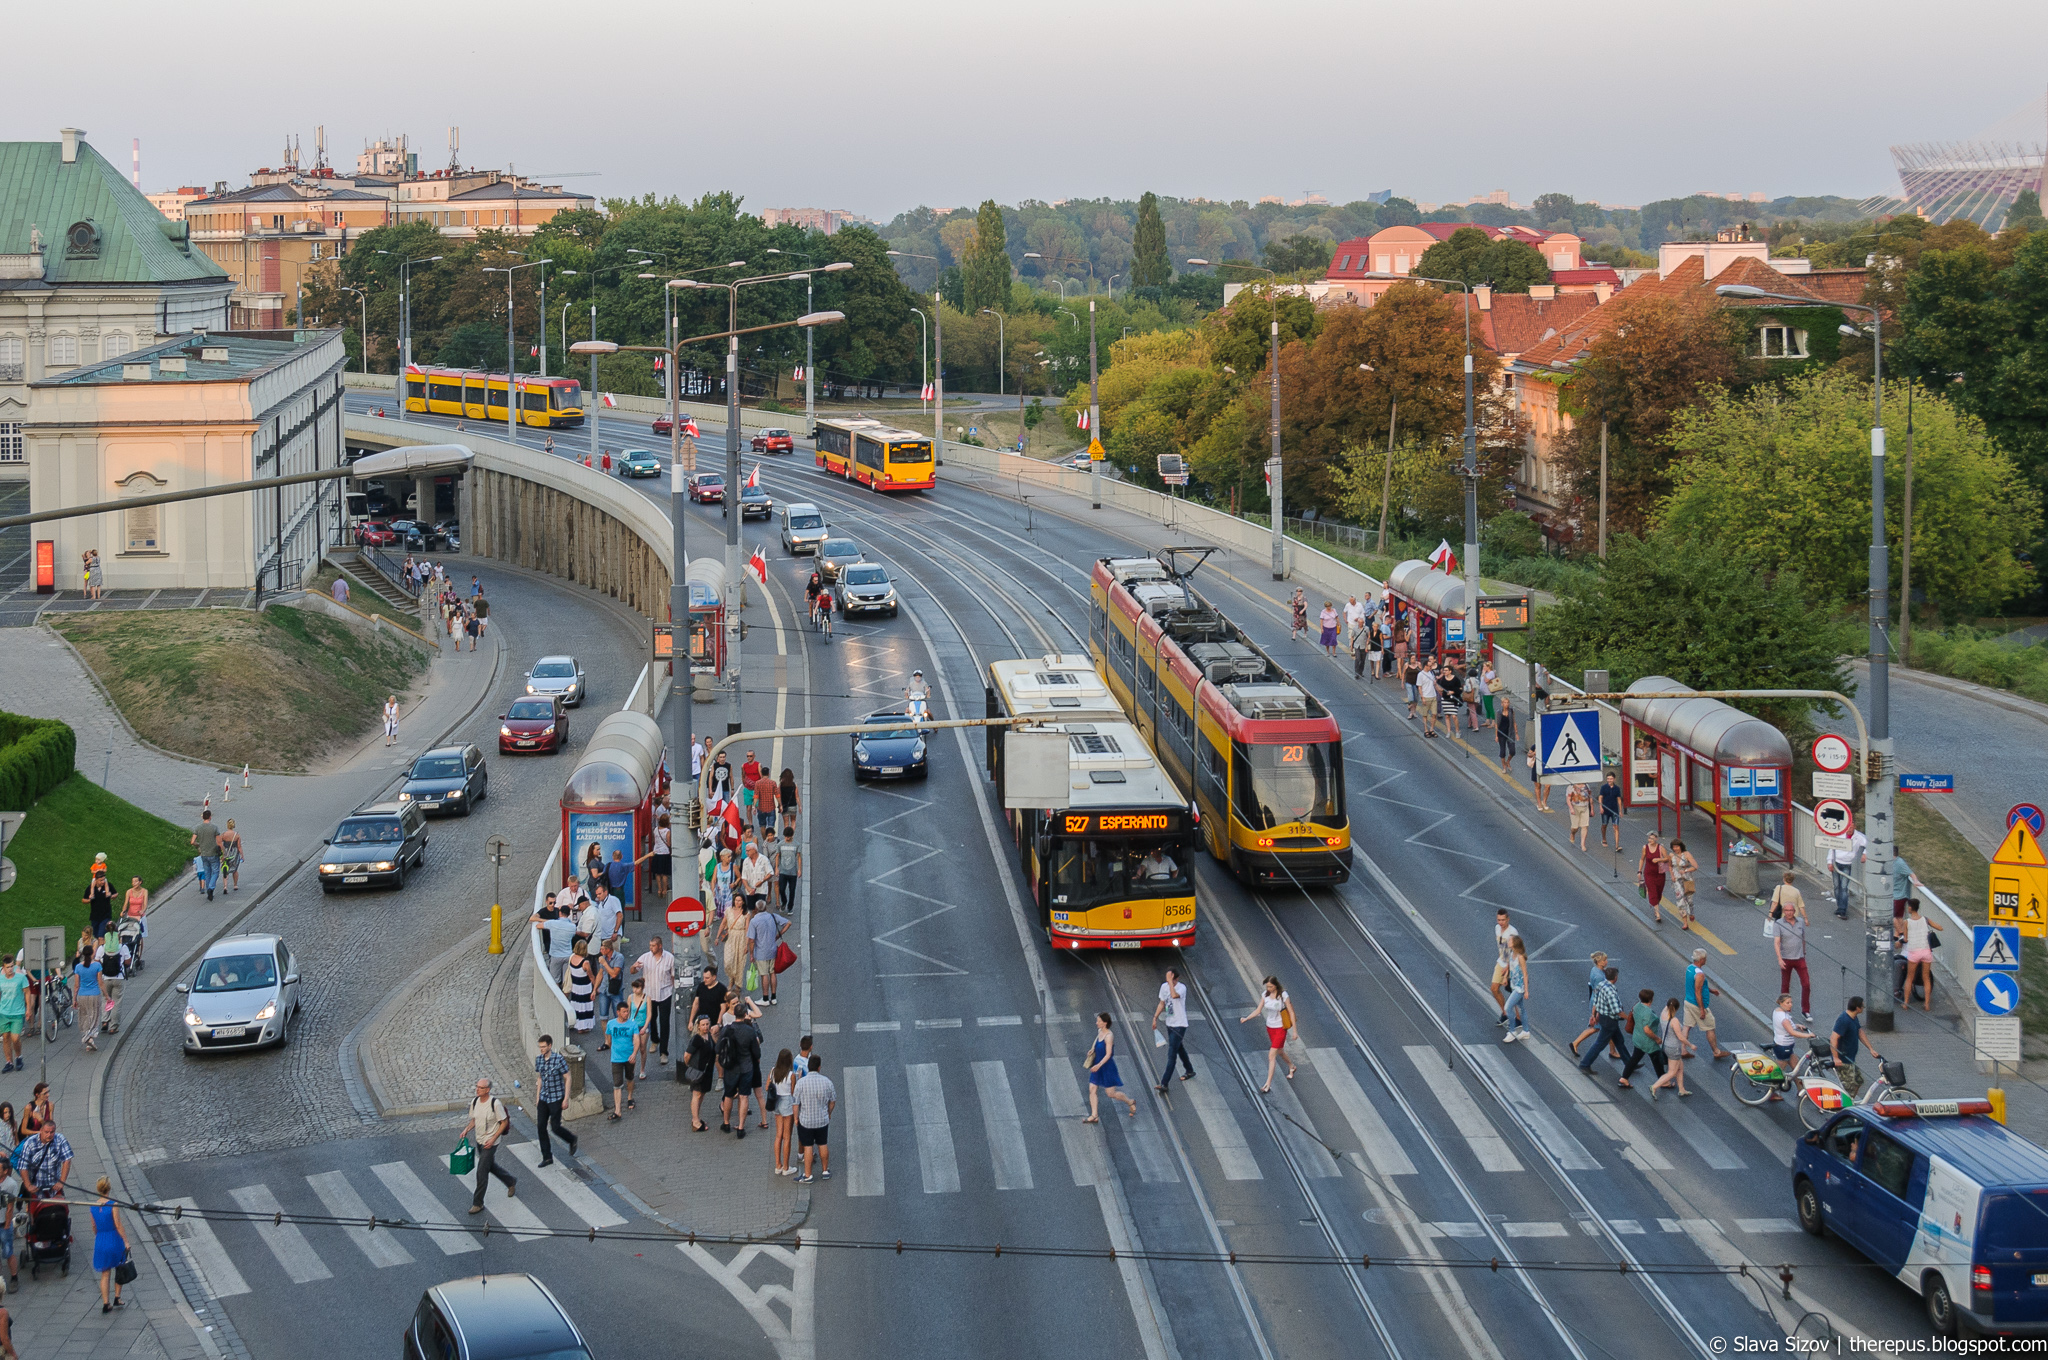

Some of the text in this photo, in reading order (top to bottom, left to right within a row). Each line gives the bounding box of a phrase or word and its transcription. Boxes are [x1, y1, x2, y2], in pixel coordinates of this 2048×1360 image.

[1282, 745, 1304, 762] 20
[1906, 779, 1947, 789] Nowy Zjazd
[1065, 815, 1168, 832] 527 ESPERANTO
[1288, 825, 1313, 835] 3193
[1993, 893, 2018, 907] BUS
[1165, 904, 1192, 916] 8586
[1817, 1093, 1841, 1101] mBank
[1917, 1102, 1958, 1115] WODOCIĄGI
